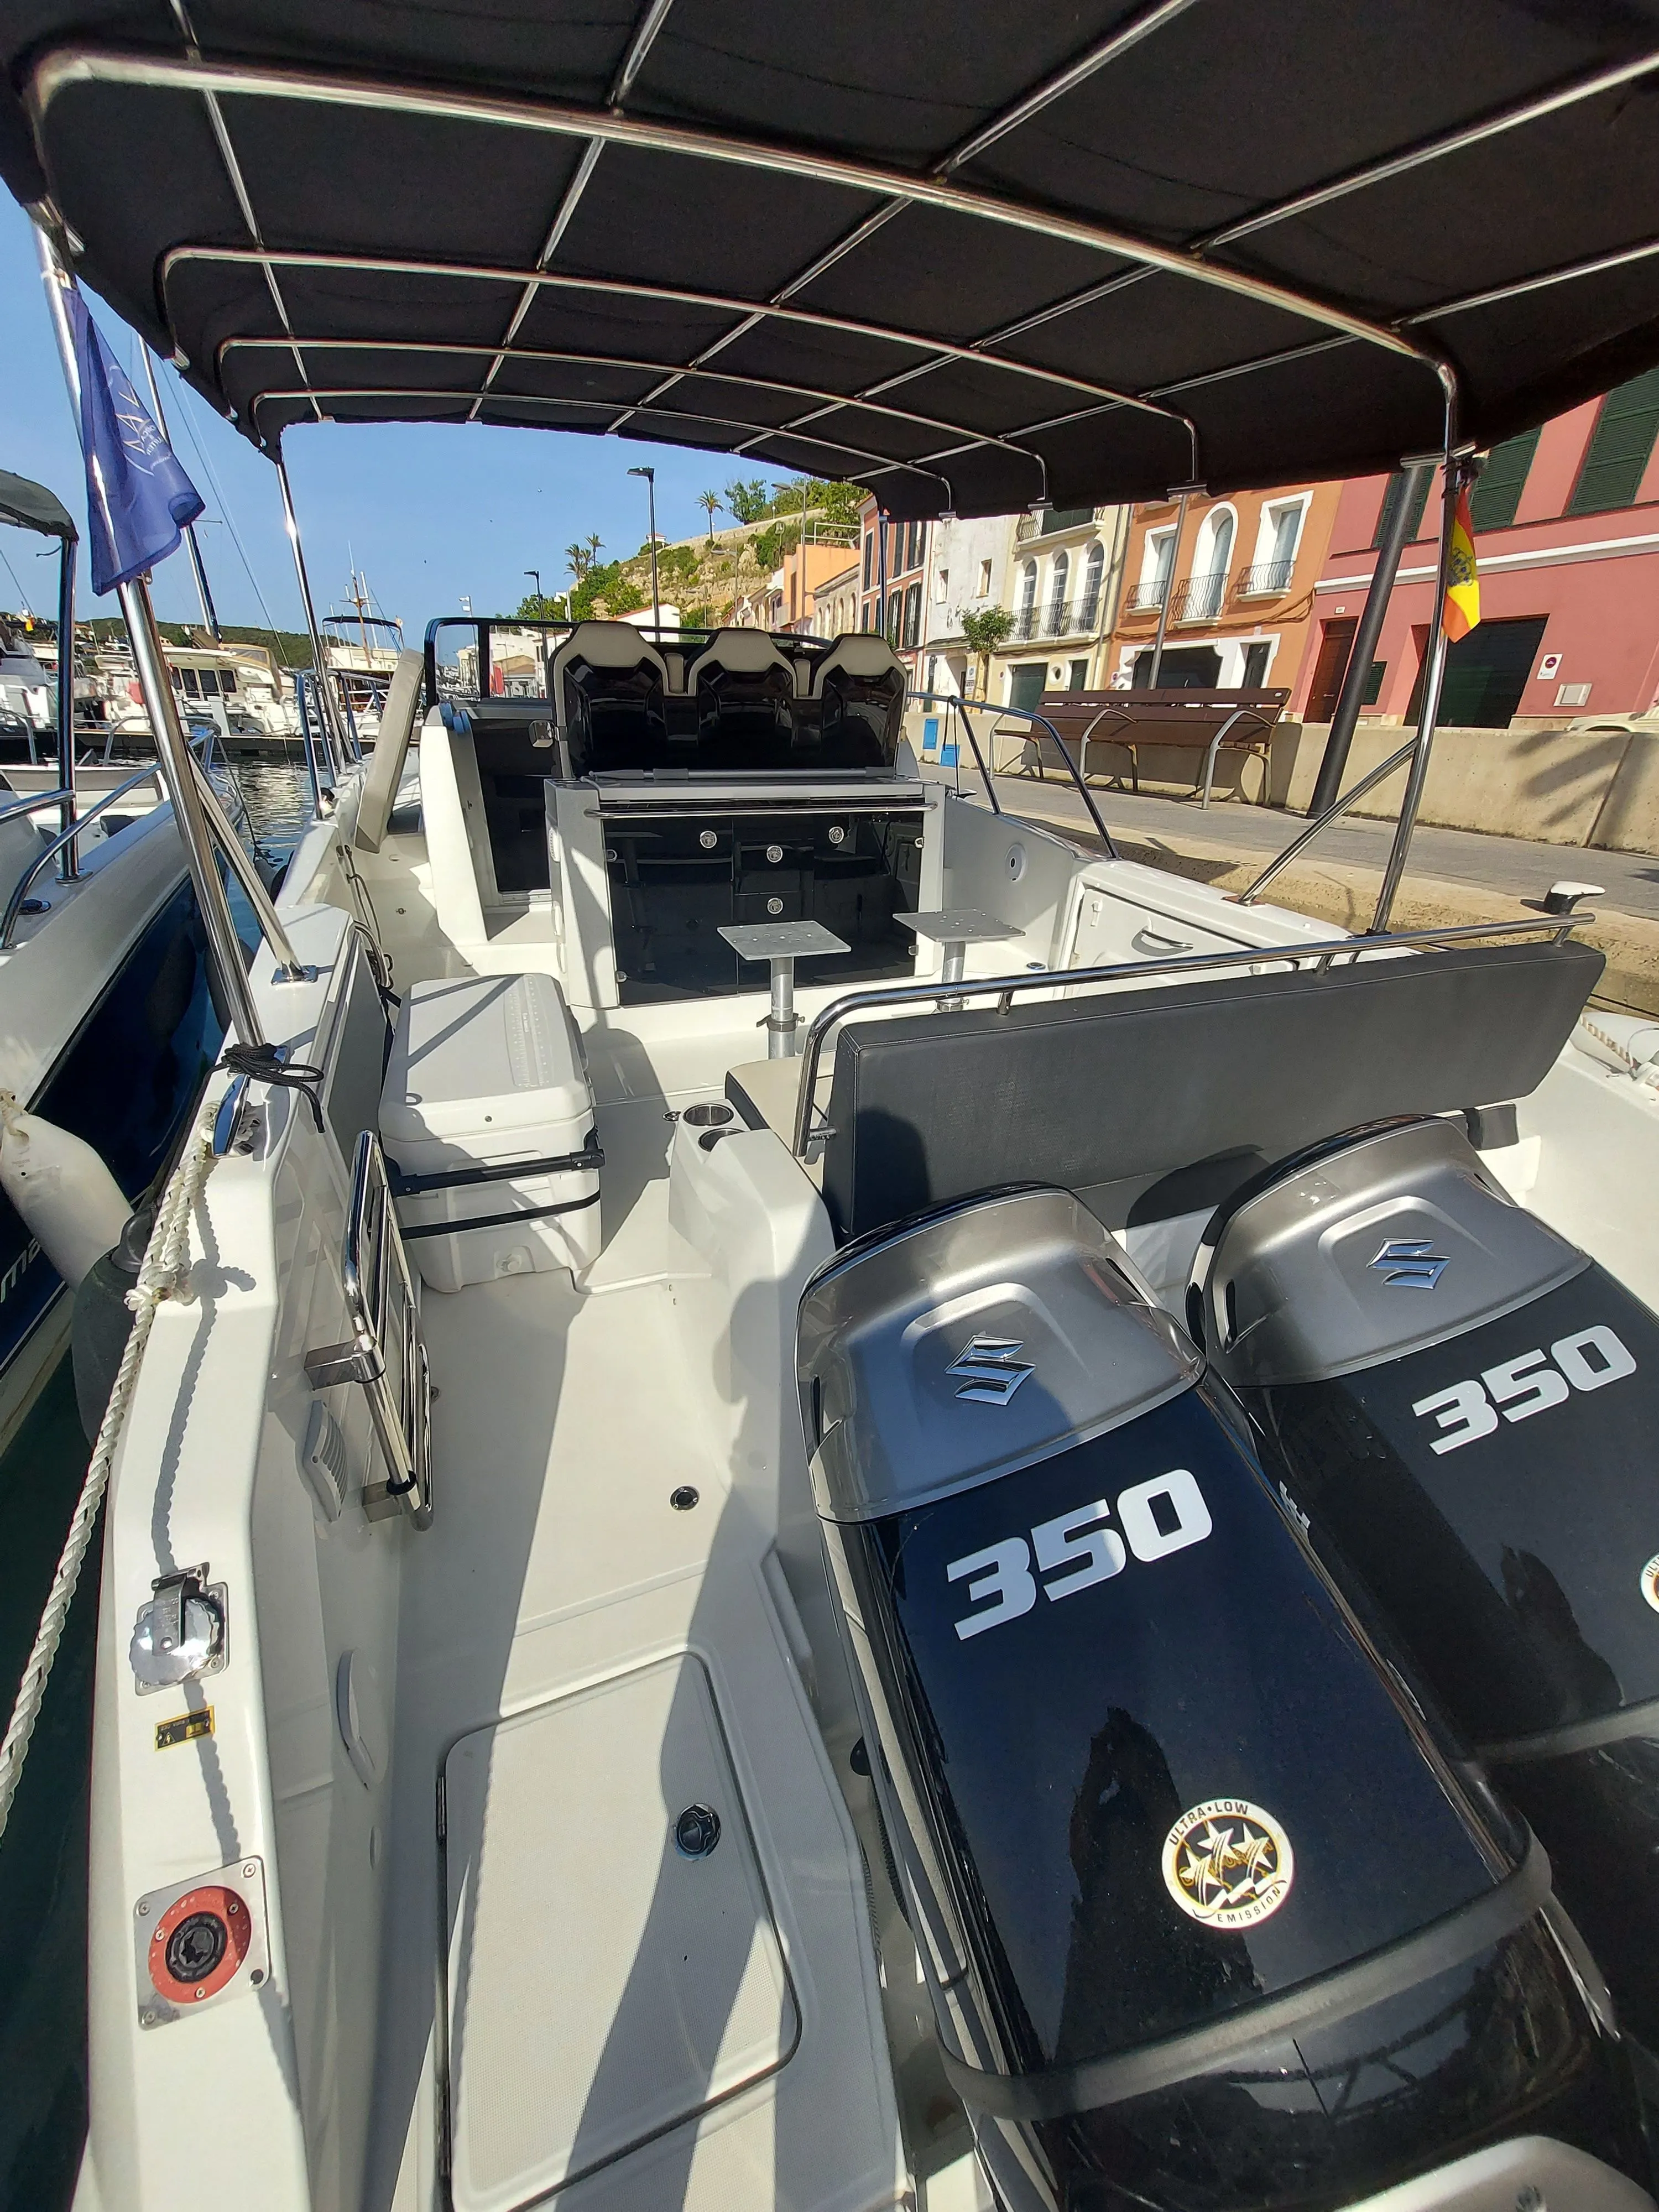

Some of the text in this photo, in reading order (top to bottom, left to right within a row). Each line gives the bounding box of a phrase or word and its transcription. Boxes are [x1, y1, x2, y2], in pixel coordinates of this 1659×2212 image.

[1412, 1325, 1637, 1455] 350
[947, 1469, 1213, 1641] 350
[1645, 1556, 1659, 1578] ULT
[1217, 1888, 1281, 1923] EMISSION
